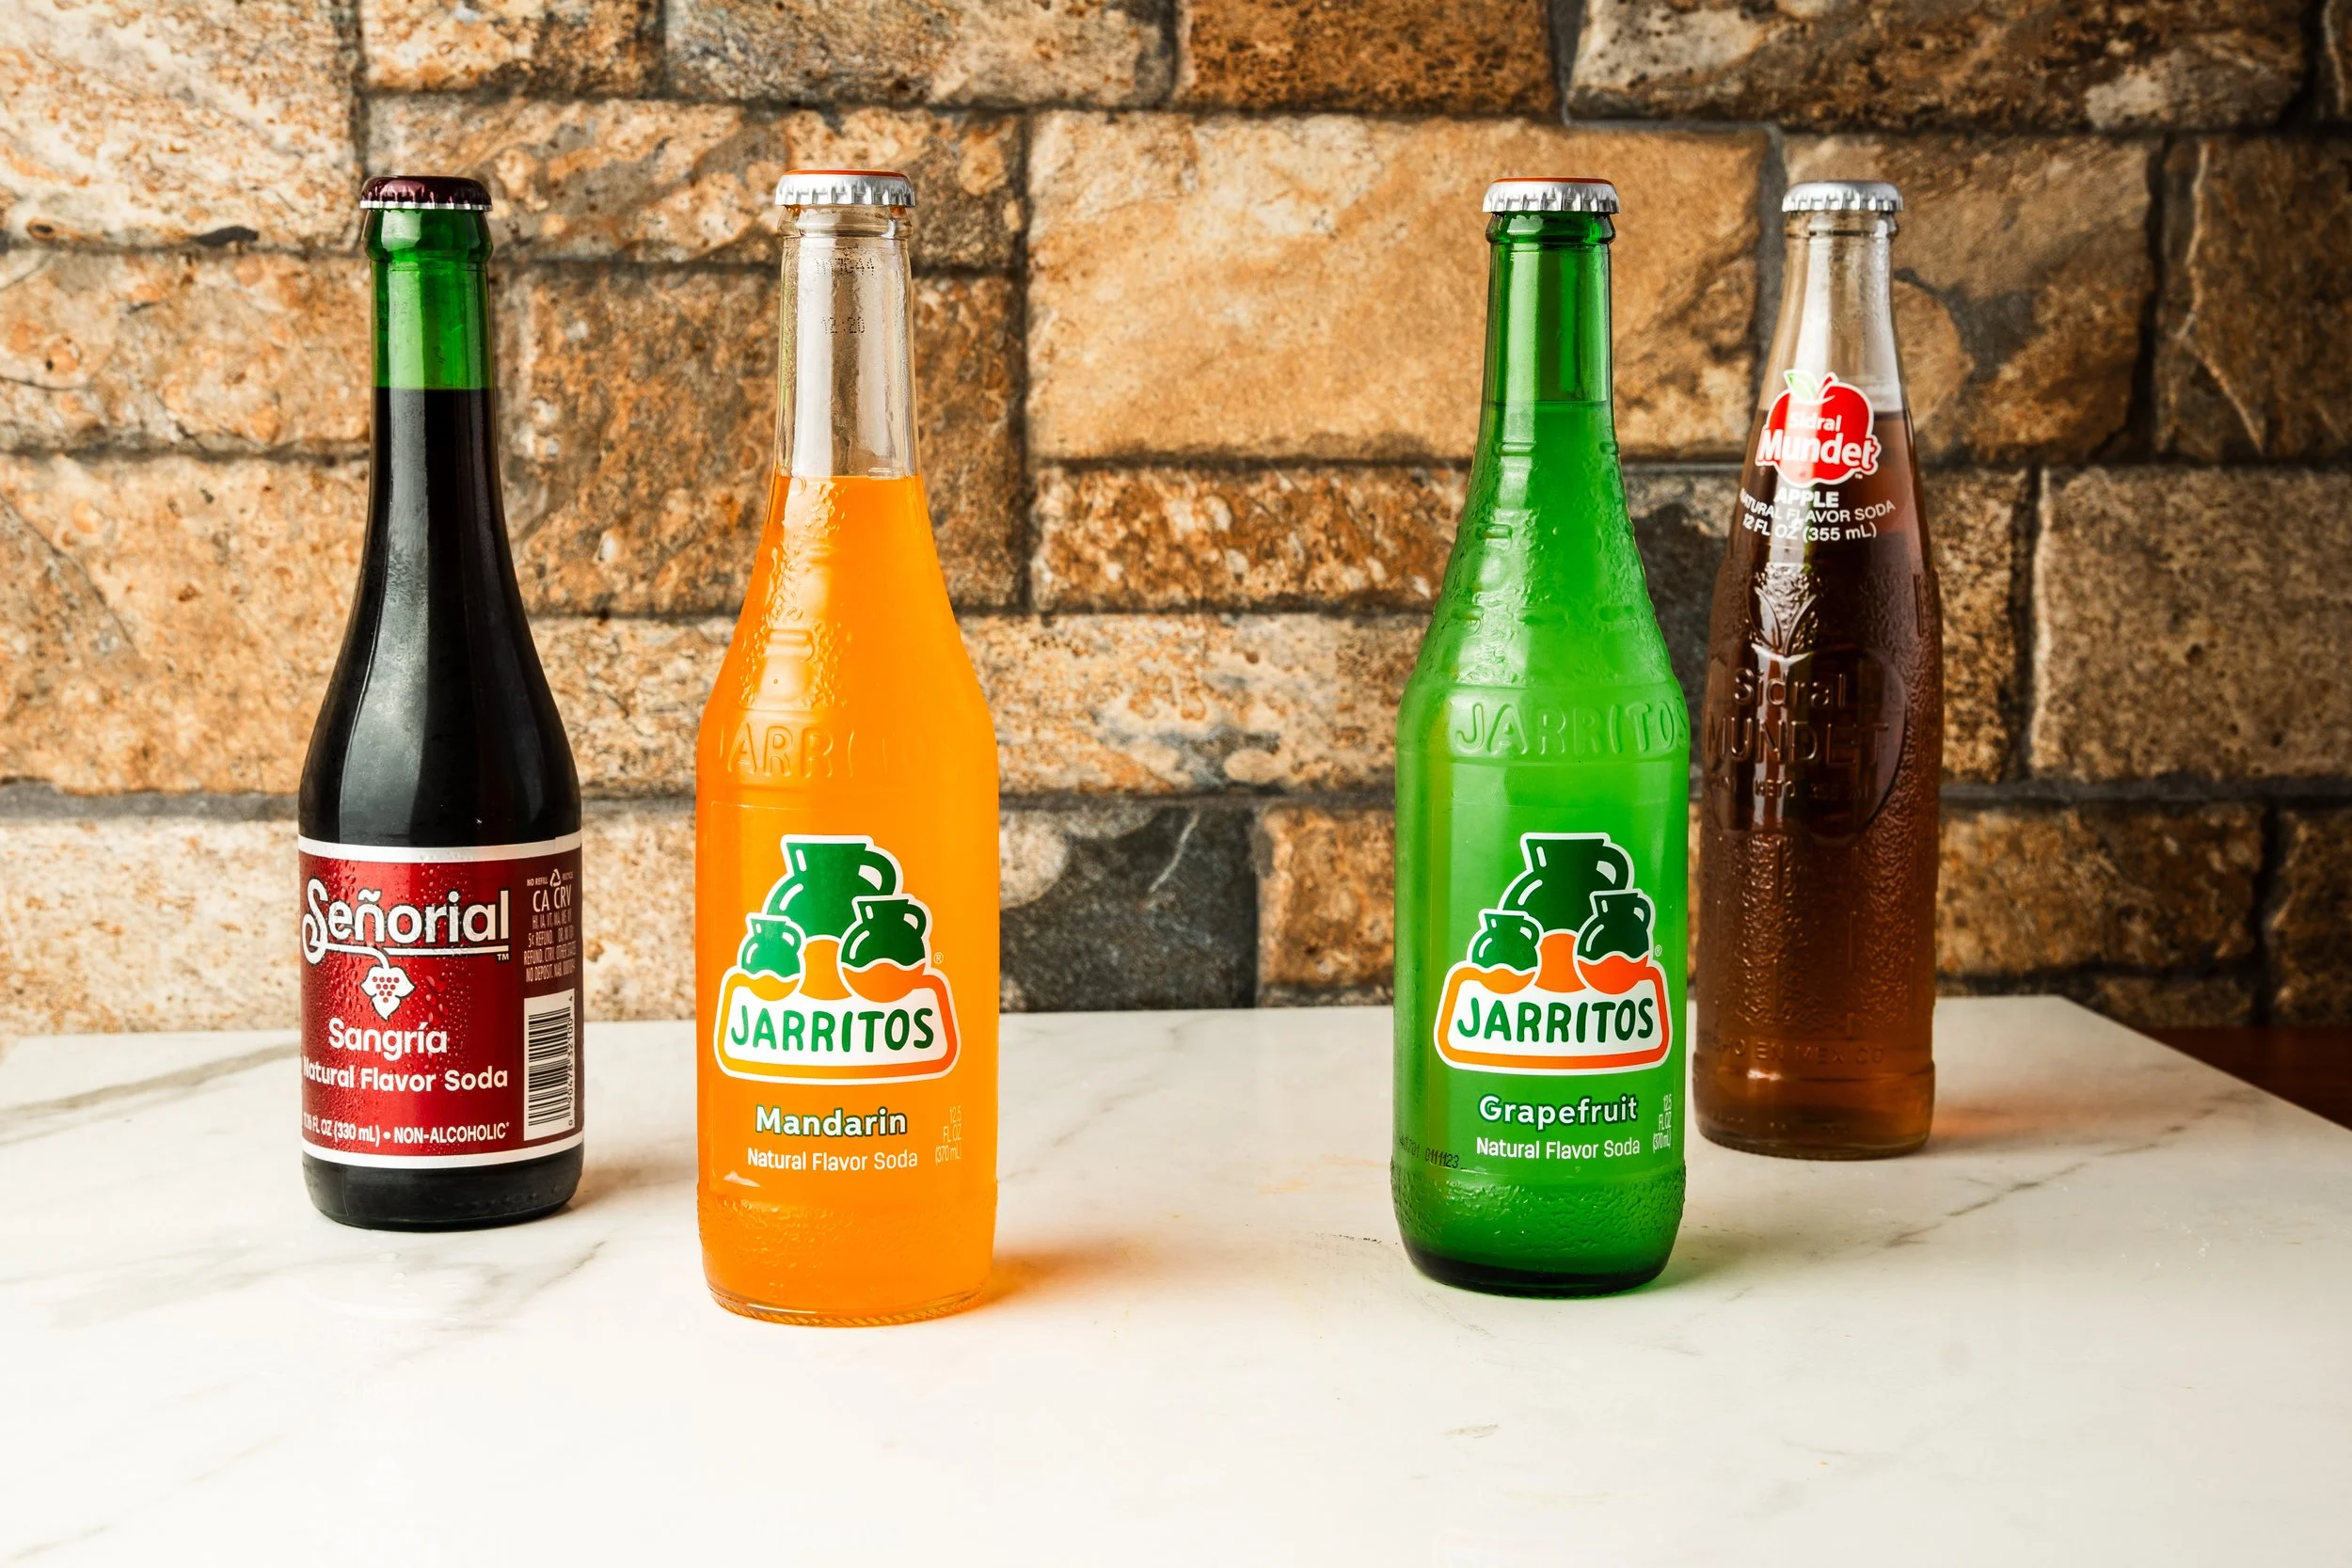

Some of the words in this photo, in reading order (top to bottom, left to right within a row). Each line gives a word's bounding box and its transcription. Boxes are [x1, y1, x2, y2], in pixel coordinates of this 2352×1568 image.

[1757, 430, 1874, 470] Mundet
[1740, 487, 1780, 519] NATURAL
[1788, 509, 1851, 524] FLAVOR
[1854, 499, 1897, 521] SODA
[1773, 487, 1839, 508] APPLE
[1742, 513, 1753, 529] 12
[1754, 519, 1771, 536] FL
[1774, 524, 1799, 540] OZ
[1802, 527, 1840, 544] (355
[1845, 521, 1877, 541] mL)
[533, 889, 549, 912] CA
[554, 884, 571, 909] CRV
[302, 879, 509, 964] Señorial
[730, 1005, 935, 1053] JARRITOS
[1457, 997, 1654, 1043] JARRITOS
[329, 1017, 448, 1061] Sangría
[303, 1055, 354, 1088] Natural
[361, 1067, 437, 1092] Flavor
[444, 1066, 508, 1091] Soda
[755, 1104, 907, 1136] Mandarin
[1479, 1095, 1638, 1131] Grapefruit
[321, 1118, 332, 1136] OZ
[334, 1120, 356, 1143] (330
[358, 1124, 380, 1147] mL)
[943, 1125, 952, 1143] FL
[953, 1123, 961, 1141] OZ
[1476, 1137, 1539, 1160] Natural
[1546, 1140, 1598, 1160] Flavor
[1603, 1137, 1640, 1156] Soda
[747, 1147, 806, 1170] Natural
[813, 1151, 867, 1171] Flavor
[874, 1148, 918, 1169] Soda
[935, 1144, 949, 1166] (370
